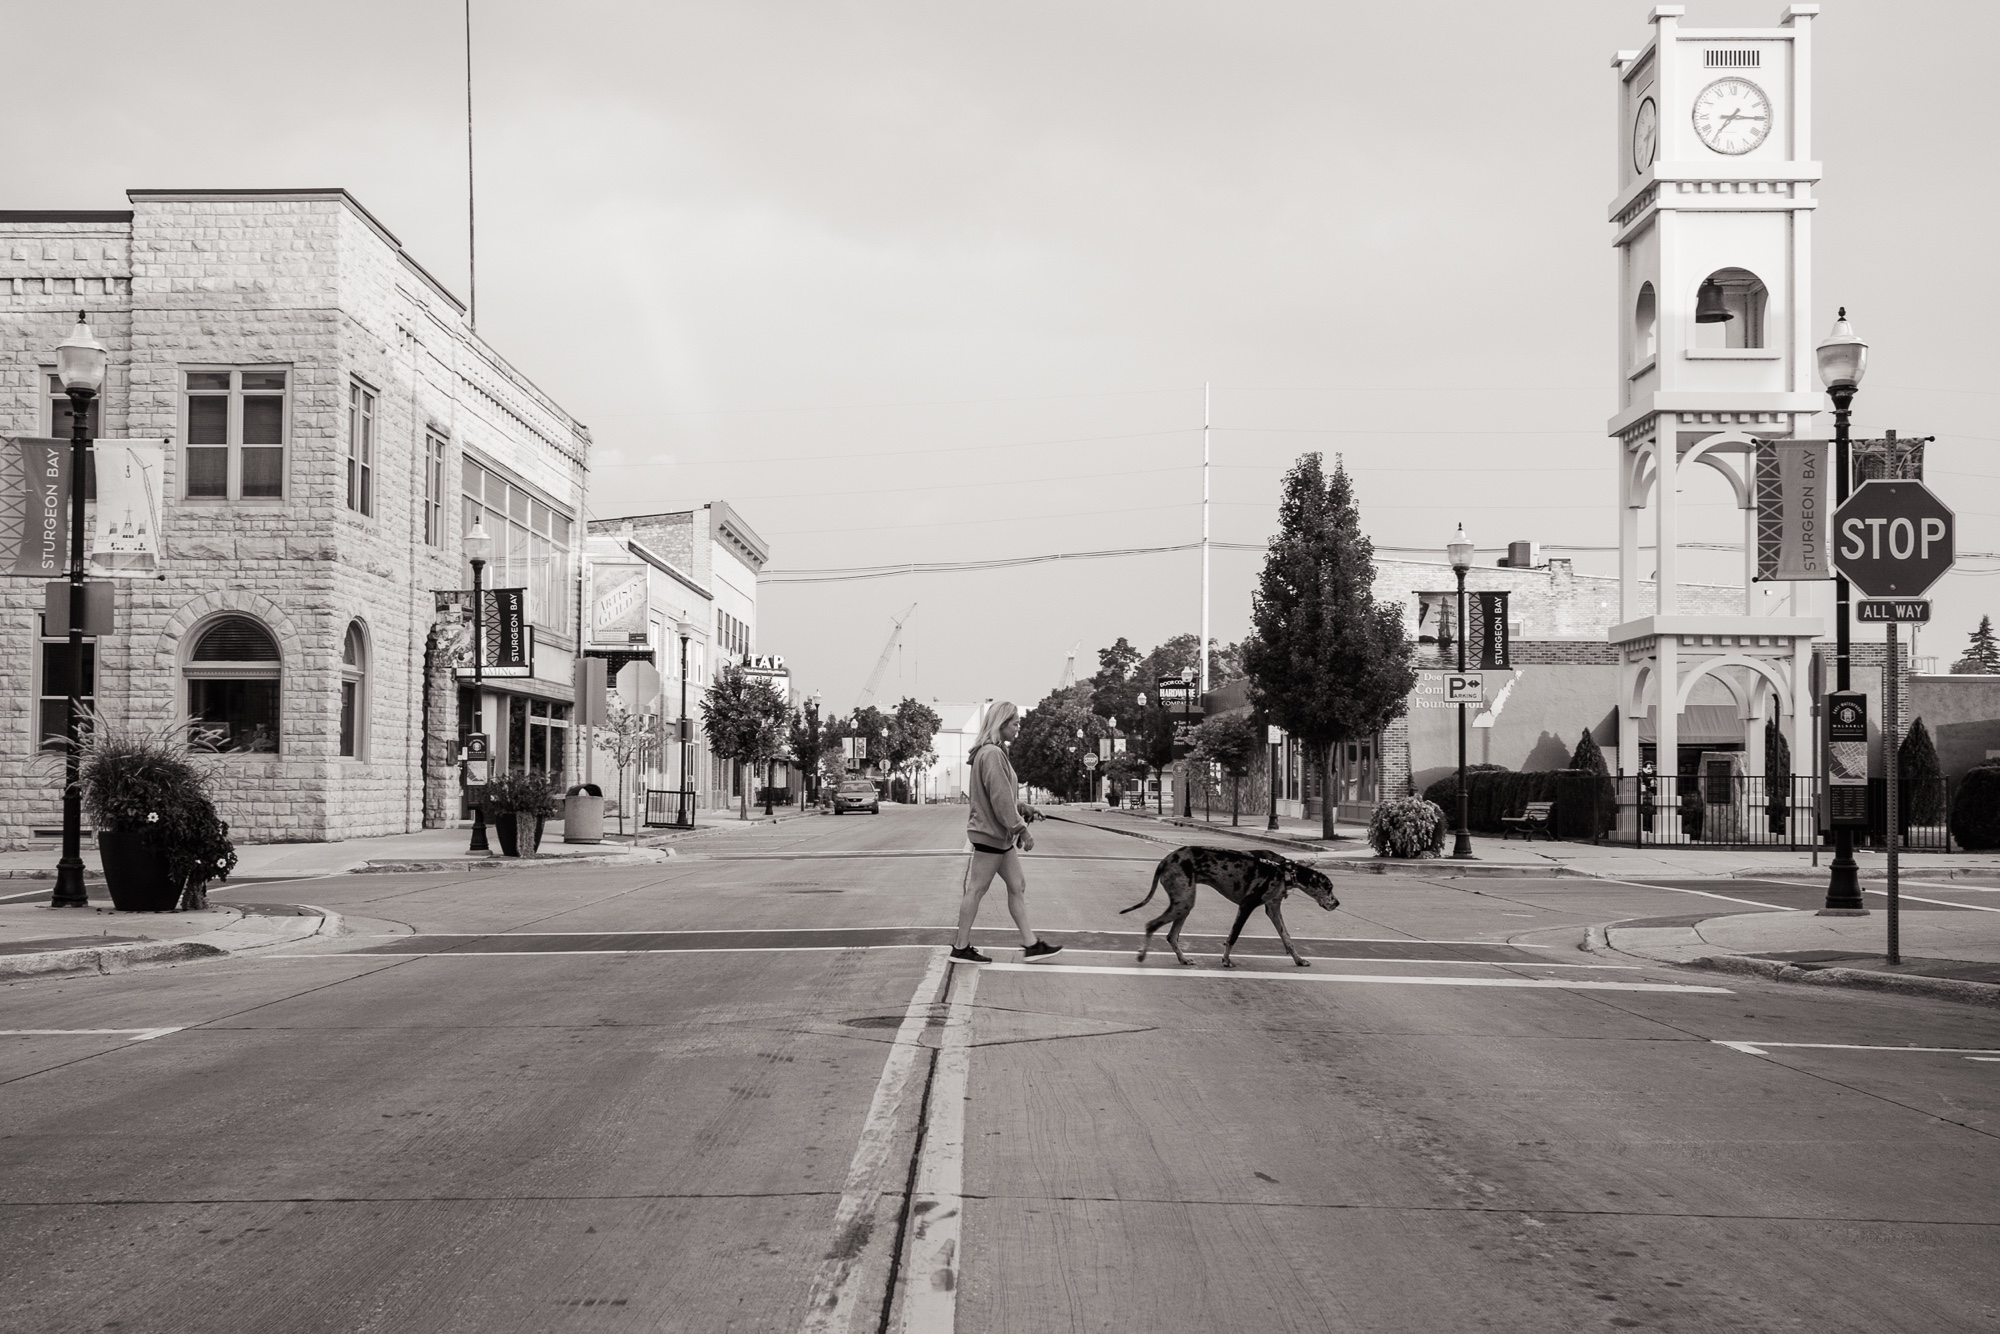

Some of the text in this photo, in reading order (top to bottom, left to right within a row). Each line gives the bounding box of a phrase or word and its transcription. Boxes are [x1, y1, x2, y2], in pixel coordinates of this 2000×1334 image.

[42, 448, 60, 569] STURGEON BAY
[1802, 450, 1816, 571] STURGEON BAY
[1841, 517, 1946, 560] STOP
[1863, 605, 1924, 618] ALL WAY
[509, 593, 519, 662] STURGEON BAY
[1494, 596, 1503, 665] STURGEON BAY
[470, 667, 517, 676] FAMING
[748, 653, 785, 669] TAP
[1423, 673, 1442, 681] Doo
[1415, 697, 1483, 709] Foundaion
